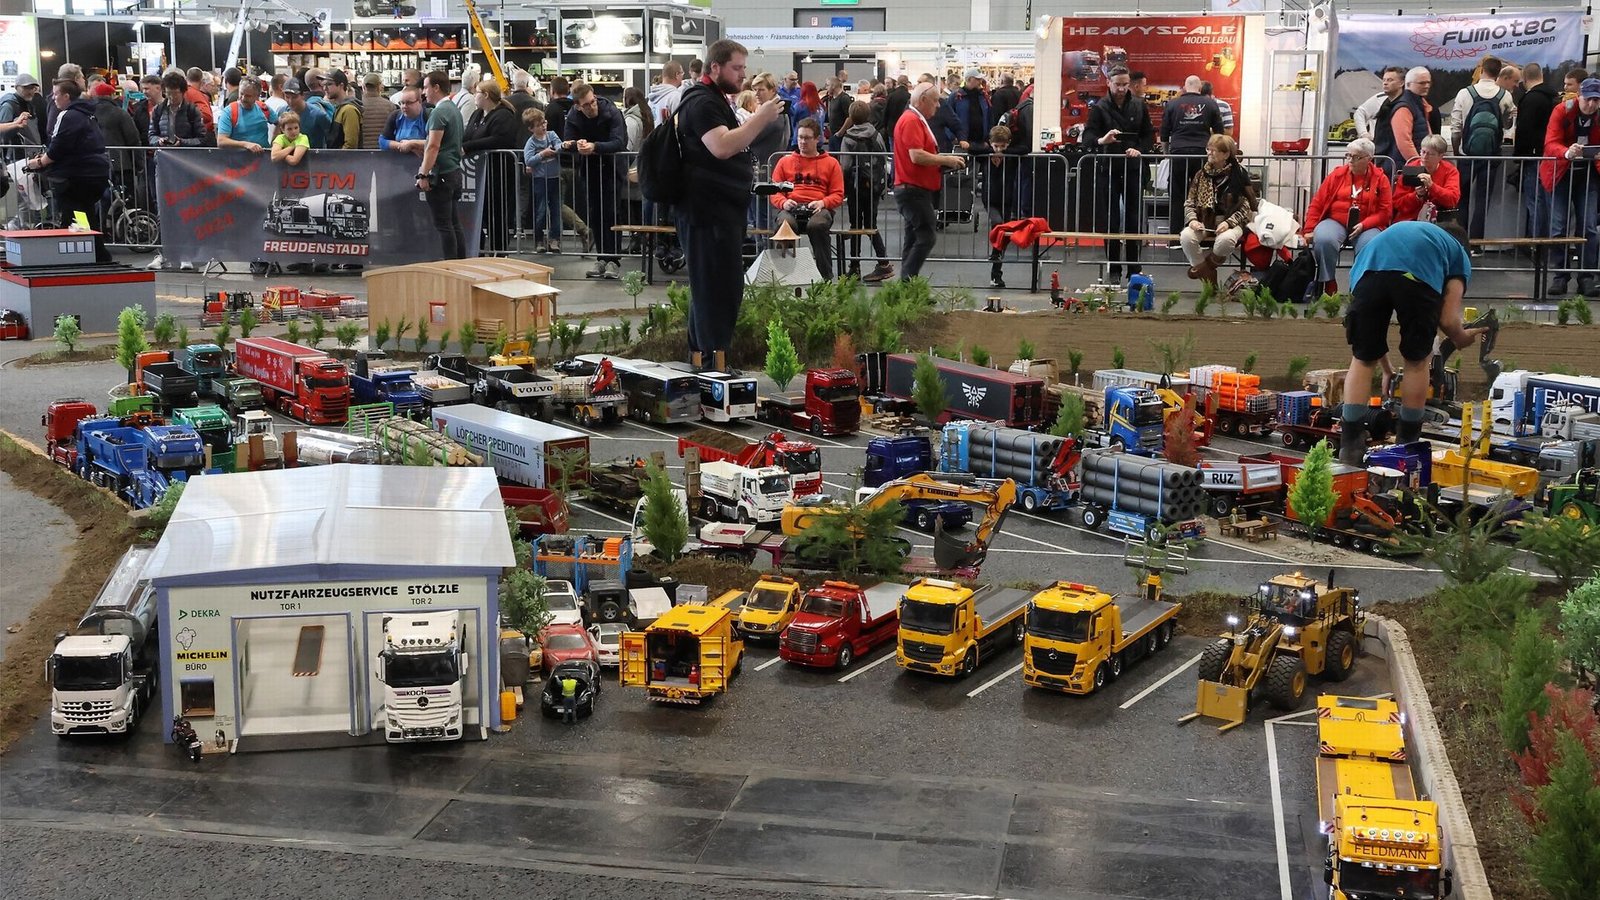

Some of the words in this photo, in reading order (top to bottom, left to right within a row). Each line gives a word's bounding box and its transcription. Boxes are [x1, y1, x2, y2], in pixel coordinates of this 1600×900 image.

[1183, 36, 1236, 45] MODELLBAU
[1491, 41, 1513, 50] mehr
[1516, 35, 1556, 47] bewegen
[281, 172, 356, 190] IGTM
[263, 241, 369, 255] FREUDENSTADT
[518, 386, 553, 394] VOLVO
[1532, 386, 1600, 413] FENST
[250, 586, 399, 601] NUTZFAHRZEUGSERVICE
[407, 584, 460, 595] STÖLZLE
[191, 610, 221, 618] DEKRA
[176, 651, 228, 660] MICHELIN
[185, 663, 208, 671] BÜRO
[1354, 844, 1428, 860] FELDMANN
